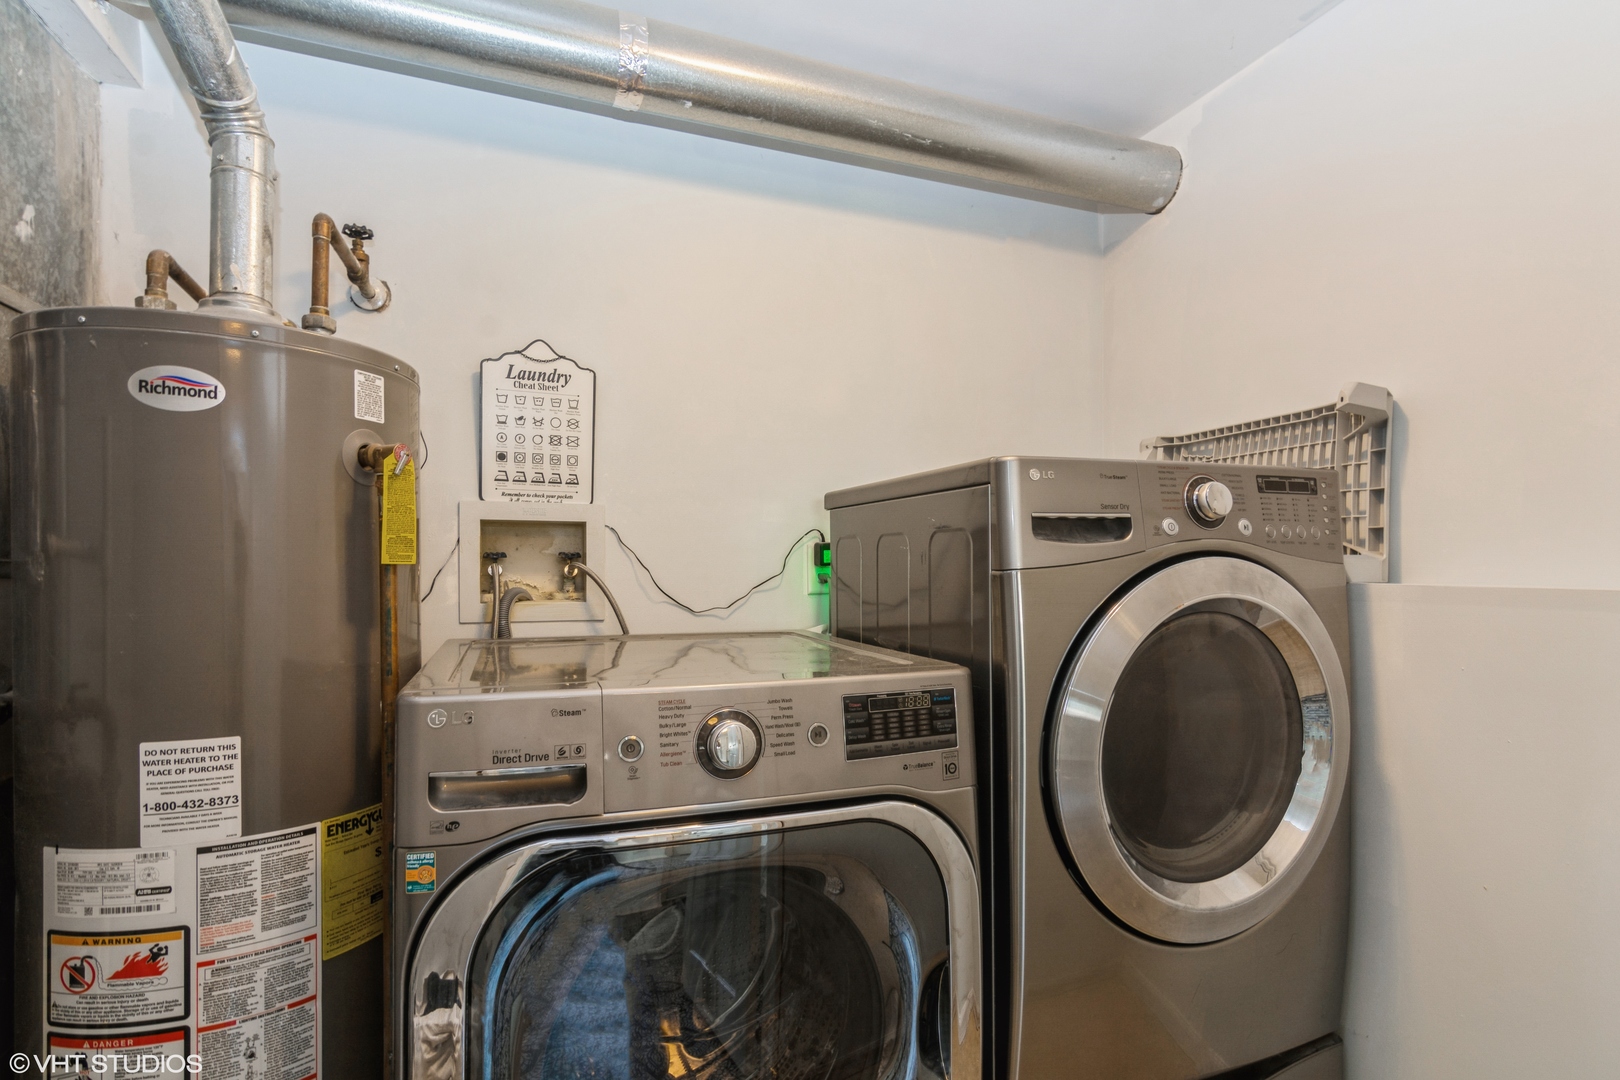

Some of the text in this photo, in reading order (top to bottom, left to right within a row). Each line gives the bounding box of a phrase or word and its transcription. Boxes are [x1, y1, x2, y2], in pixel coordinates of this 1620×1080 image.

[505, 364, 572, 388] Laundry
[138, 380, 218, 399] Richmond
[514, 381, 559, 392] Cheat Sheet
[452, 710, 474, 725] LG
[180, 746, 215, 754] RETURN
[142, 759, 171, 767] WATER
[174, 757, 206, 765] HEATER
[492, 752, 549, 765] Direct Drive
[188, 764, 234, 774] PURCHASE
[945, 763, 957, 775] 10
[143, 795, 239, 812] 1-800-432-8373
[212, 842, 246, 852] INSTALLATION
[259, 835, 285, 845] OPERATION
[93, 937, 141, 945] WARNING
[93, 1040, 134, 1048] DANGER
